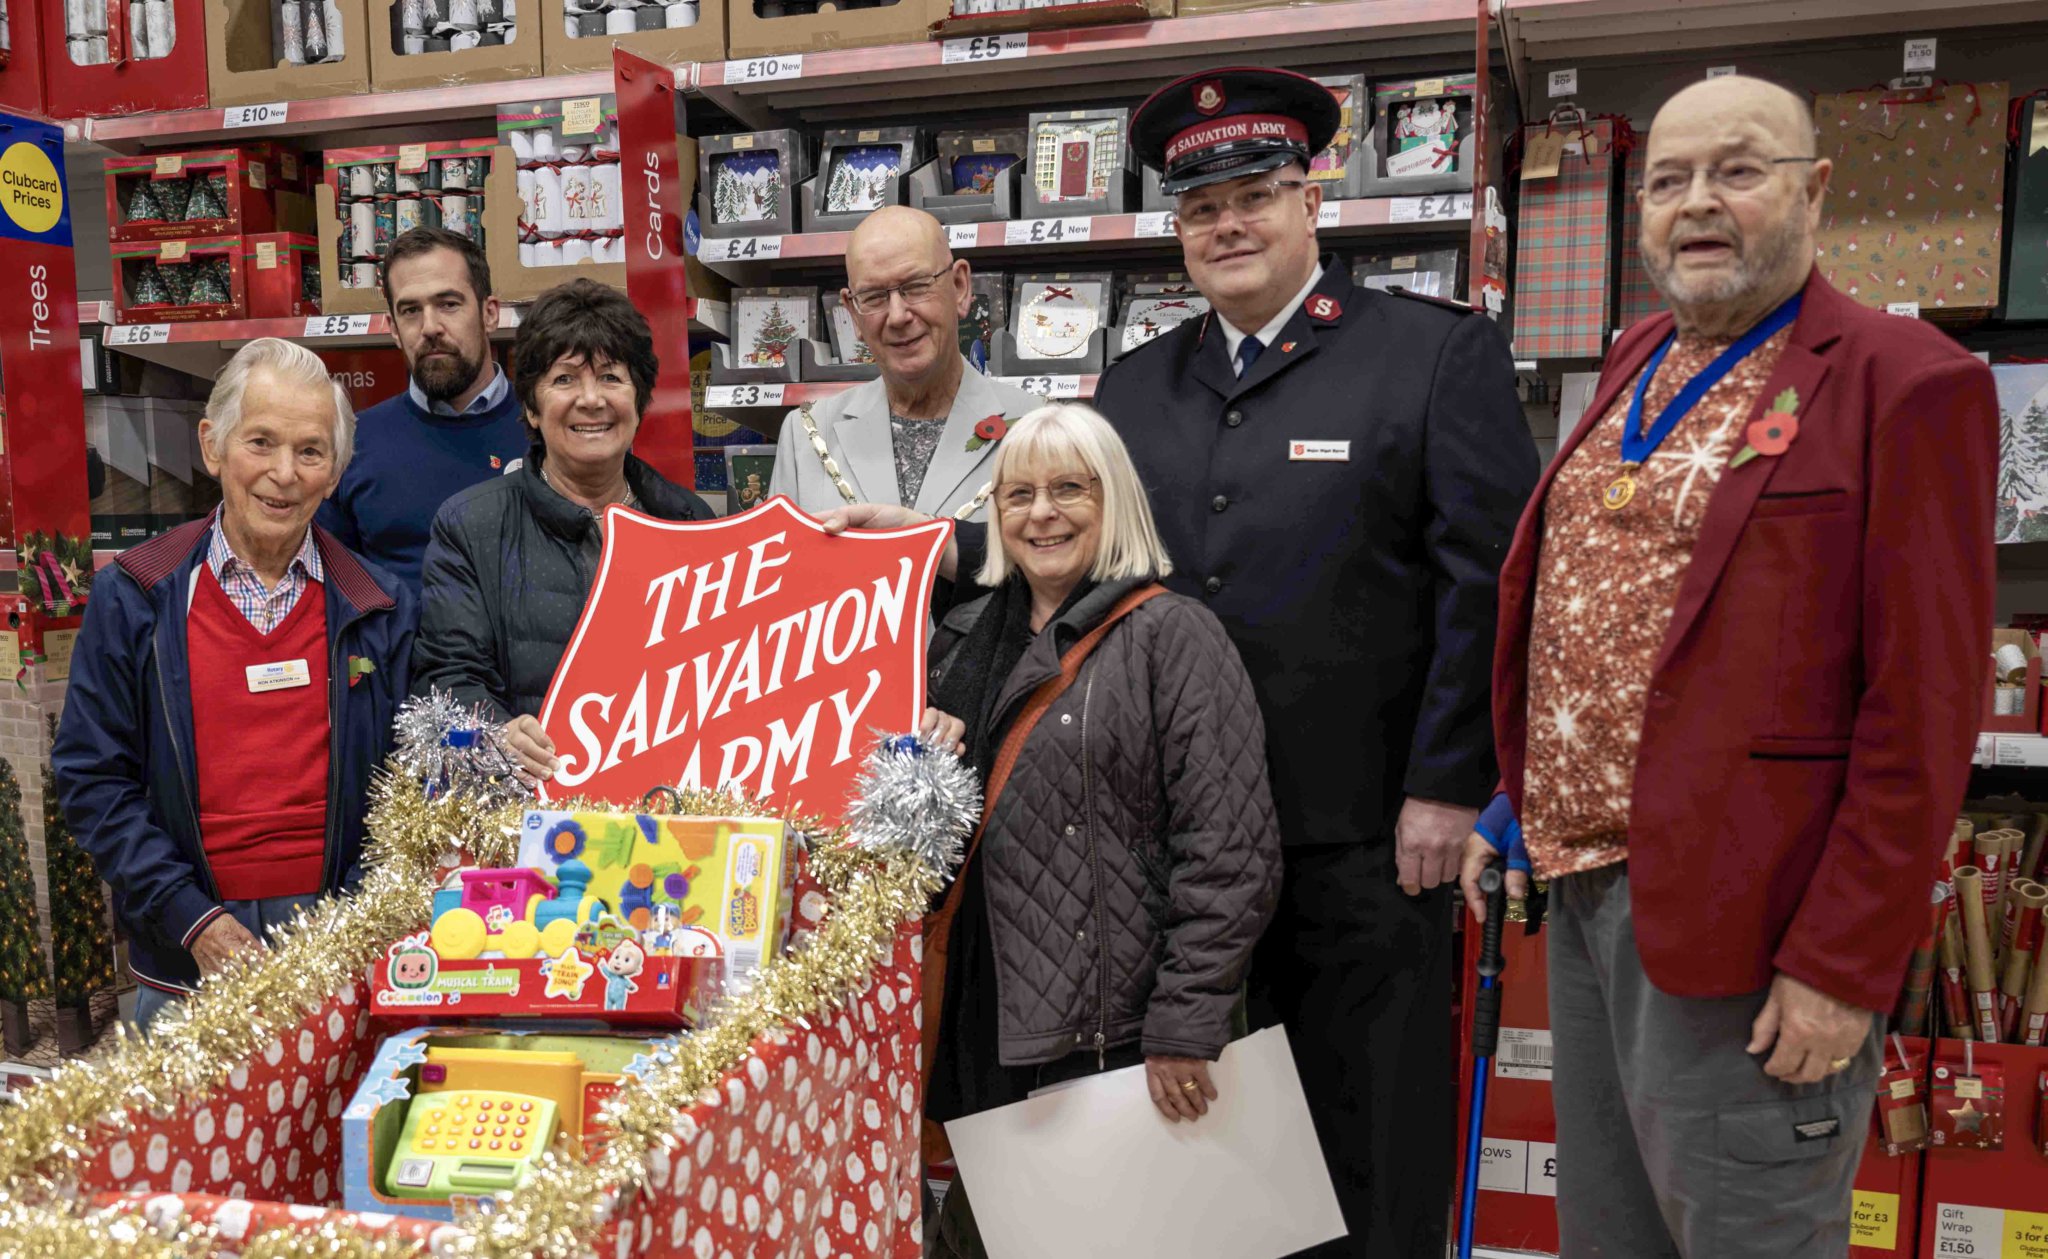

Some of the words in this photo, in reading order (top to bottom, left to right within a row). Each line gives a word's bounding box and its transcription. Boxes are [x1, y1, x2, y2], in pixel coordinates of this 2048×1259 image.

[968, 36, 1001, 59] £5
[1006, 41, 1027, 50] New
[1908, 49, 1932, 58] £1.50
[747, 60, 779, 78] £10
[781, 63, 801, 71] New
[242, 107, 268, 122] £10
[1166, 144, 1178, 161] THE
[1177, 123, 1248, 153] SALVATION
[1251, 122, 1287, 136] ARMY
[2, 170, 58, 194] Clubcard
[13, 189, 52, 209] Prices
[643, 151, 663, 261] Cards
[1418, 195, 1457, 219] £4
[686, 221, 698, 245] New
[956, 231, 976, 240] New
[1030, 219, 1064, 242] £4
[1068, 225, 1089, 234] New
[727, 238, 758, 259] £4
[761, 243, 780, 251] New
[29, 264, 51, 351] Trees
[1314, 299, 1333, 316] S
[127, 325, 152, 343] £6
[324, 316, 350, 334] £5
[352, 320, 369, 328] New
[329, 371, 376, 388] mas
[1020, 377, 1053, 396] £3
[1057, 382, 1078, 391] New
[731, 386, 760, 406] £3
[763, 391, 782, 399] New
[644, 530, 792, 649] THE
[552, 556, 913, 788] SALVATION
[674, 668, 882, 802] ARMY
[437, 977, 478, 988] MUSICAL
[482, 975, 514, 986] TRAIN
[1480, 1147, 1512, 1159] OWS
[1859, 1201, 1875, 1209] Any
[1942, 1208, 1965, 1220] Gift
[1854, 1210, 1872, 1220] for
[1874, 1213, 1888, 1223] £3
[1941, 1221, 1974, 1234] Wrap
[2015, 1231, 2023, 1240] 3
[2025, 1232, 2041, 1242] for
[1940, 1241, 1975, 1255] £1.50
[2025, 1251, 2044, 1259] Price
